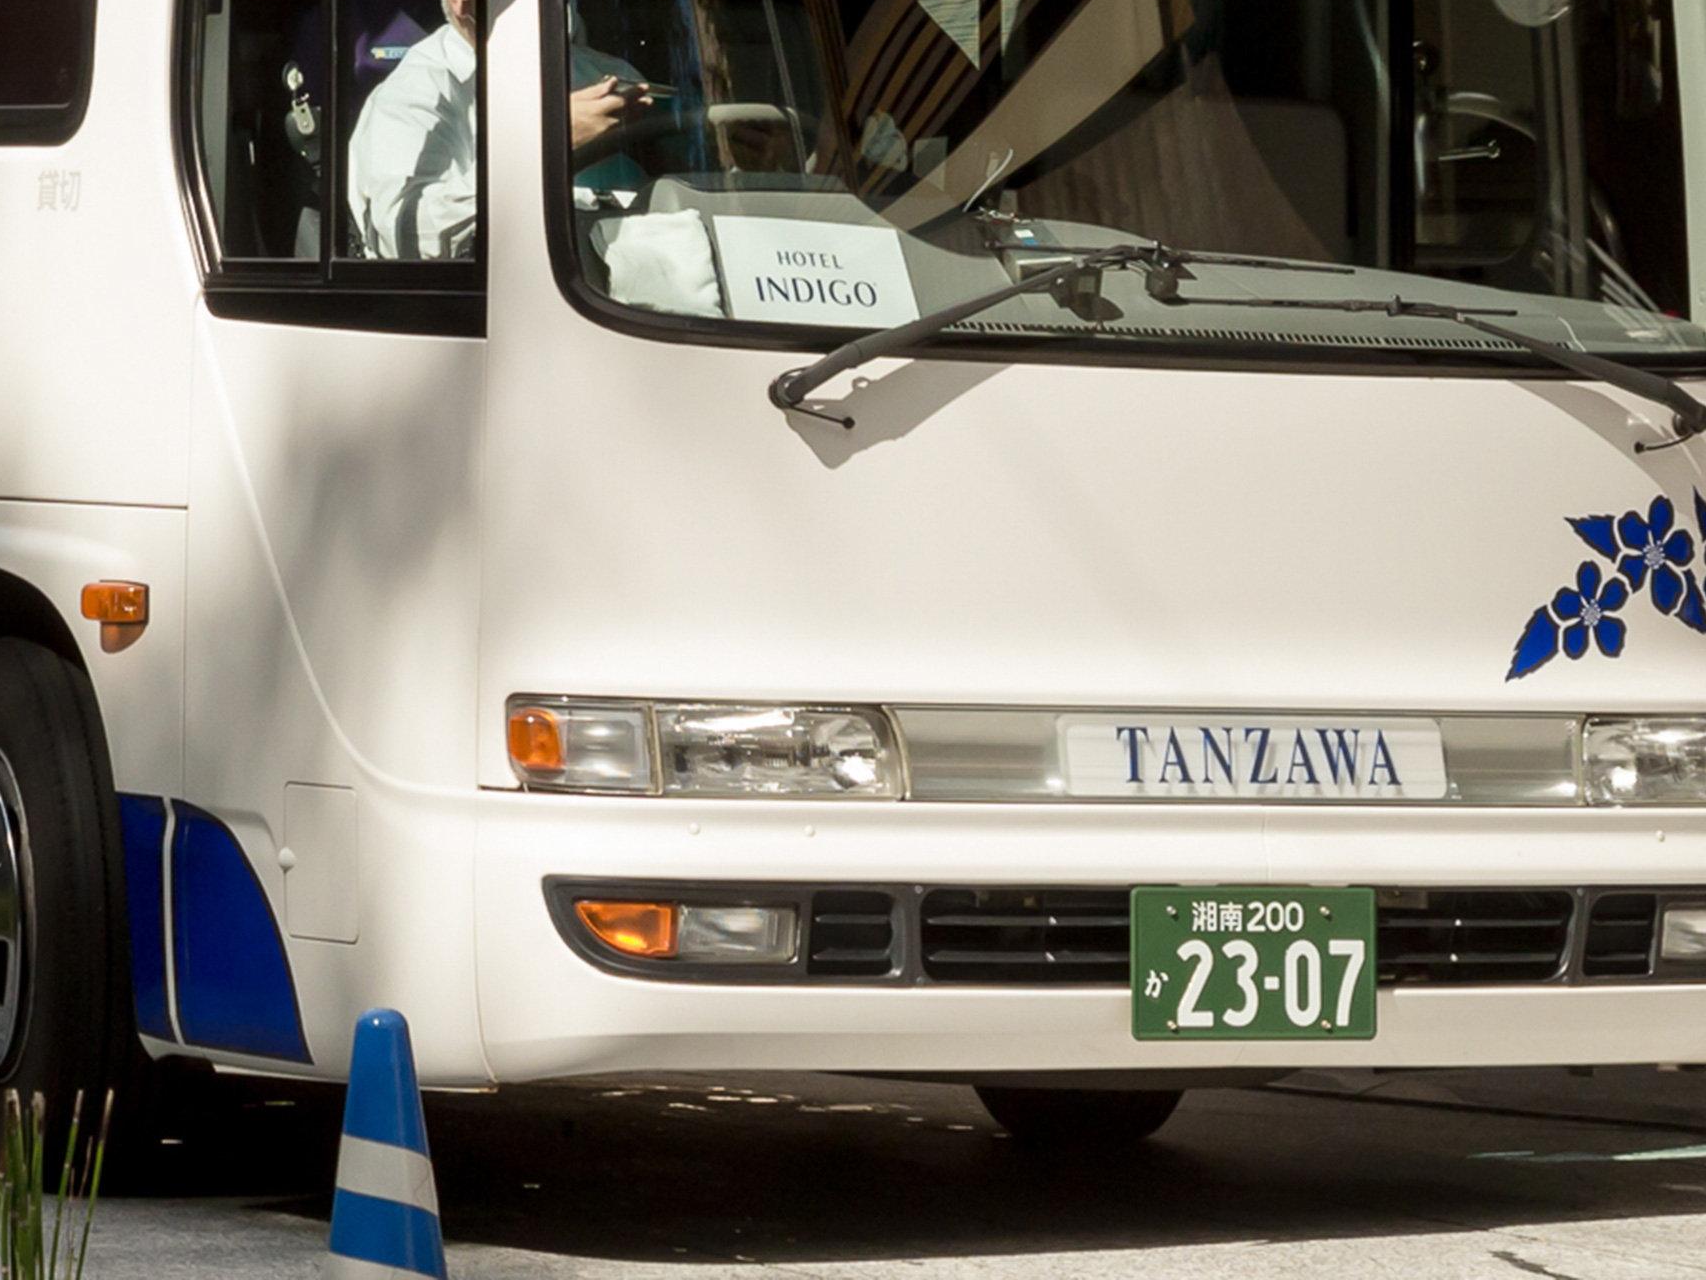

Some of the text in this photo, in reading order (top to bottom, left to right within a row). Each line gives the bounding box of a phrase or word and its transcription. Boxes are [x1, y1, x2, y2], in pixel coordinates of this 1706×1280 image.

[36, 169, 83, 212] 貸切
[776, 250, 844, 269] HOTEL
[755, 276, 877, 307] INDIGO
[1116, 726, 1402, 785] TANZAWA
[1144, 939, 1366, 1028] か 23-07
